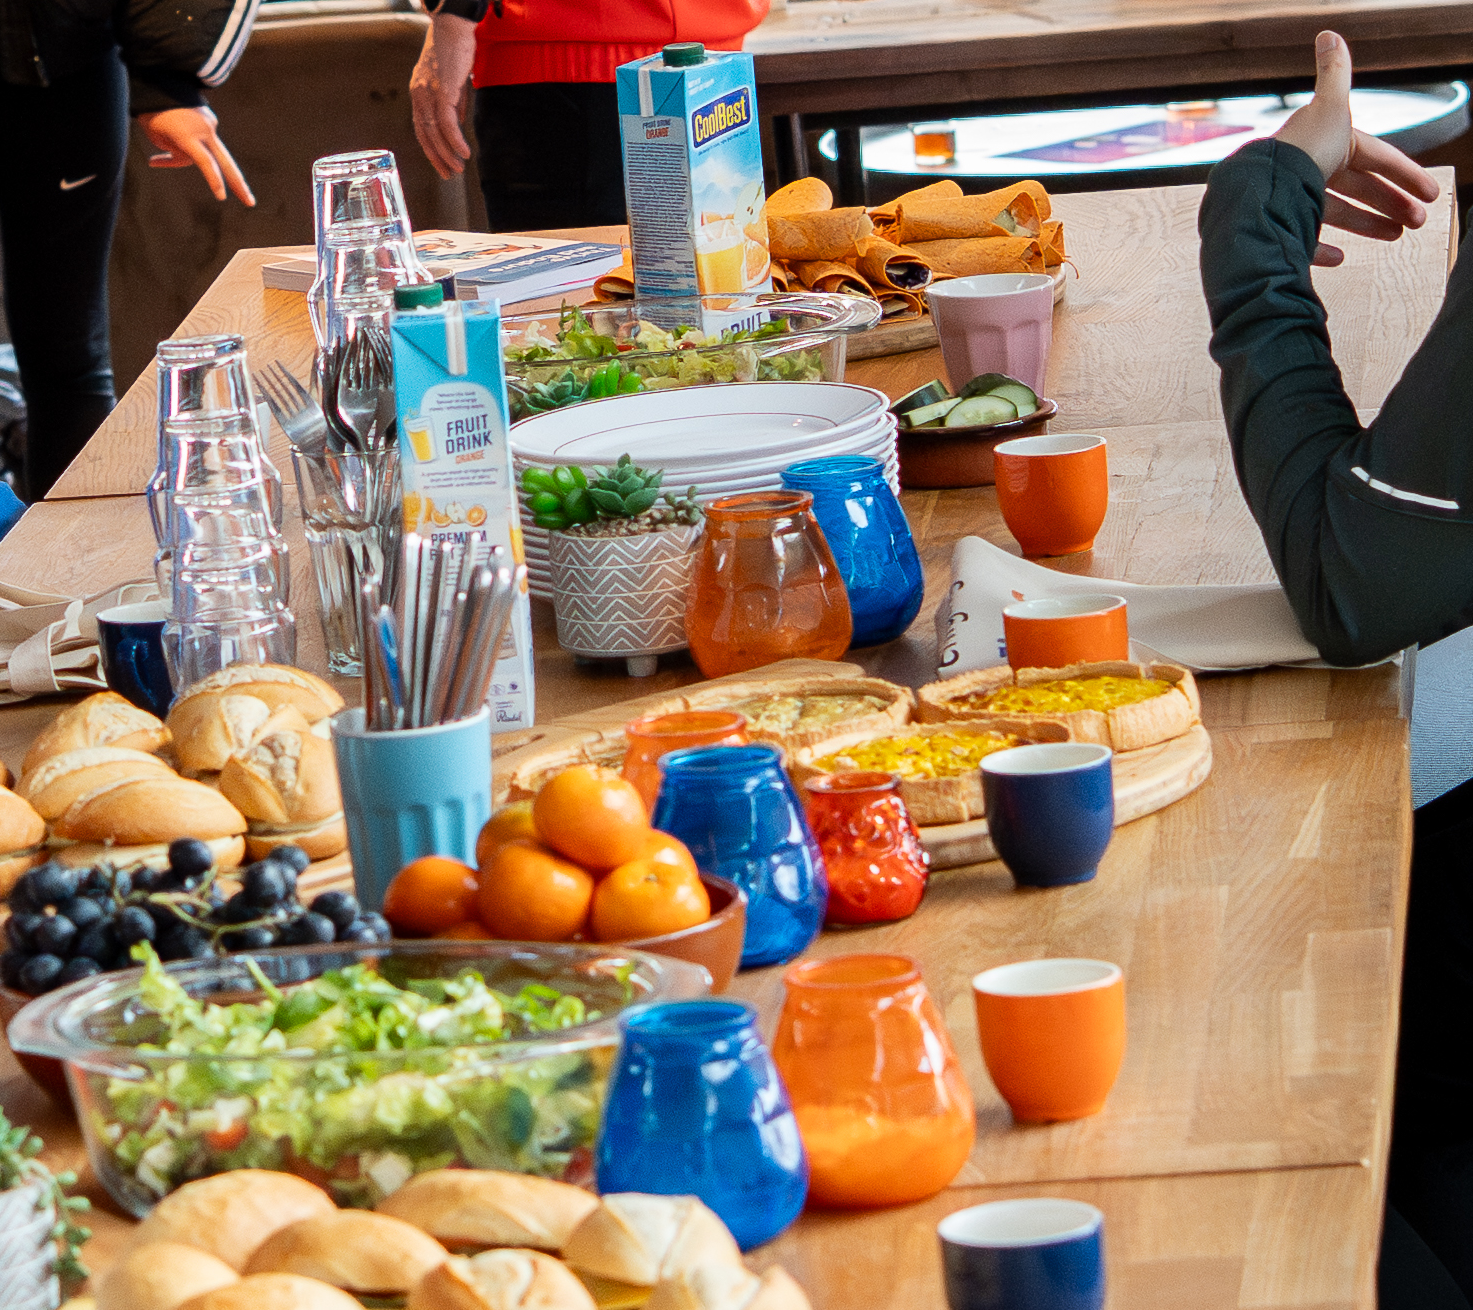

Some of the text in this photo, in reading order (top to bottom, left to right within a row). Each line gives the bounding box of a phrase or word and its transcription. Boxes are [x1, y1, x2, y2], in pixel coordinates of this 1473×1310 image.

[695, 95, 748, 143] CoolBest
[447, 414, 488, 437] FRUIT
[445, 431, 492, 455] DRINK
